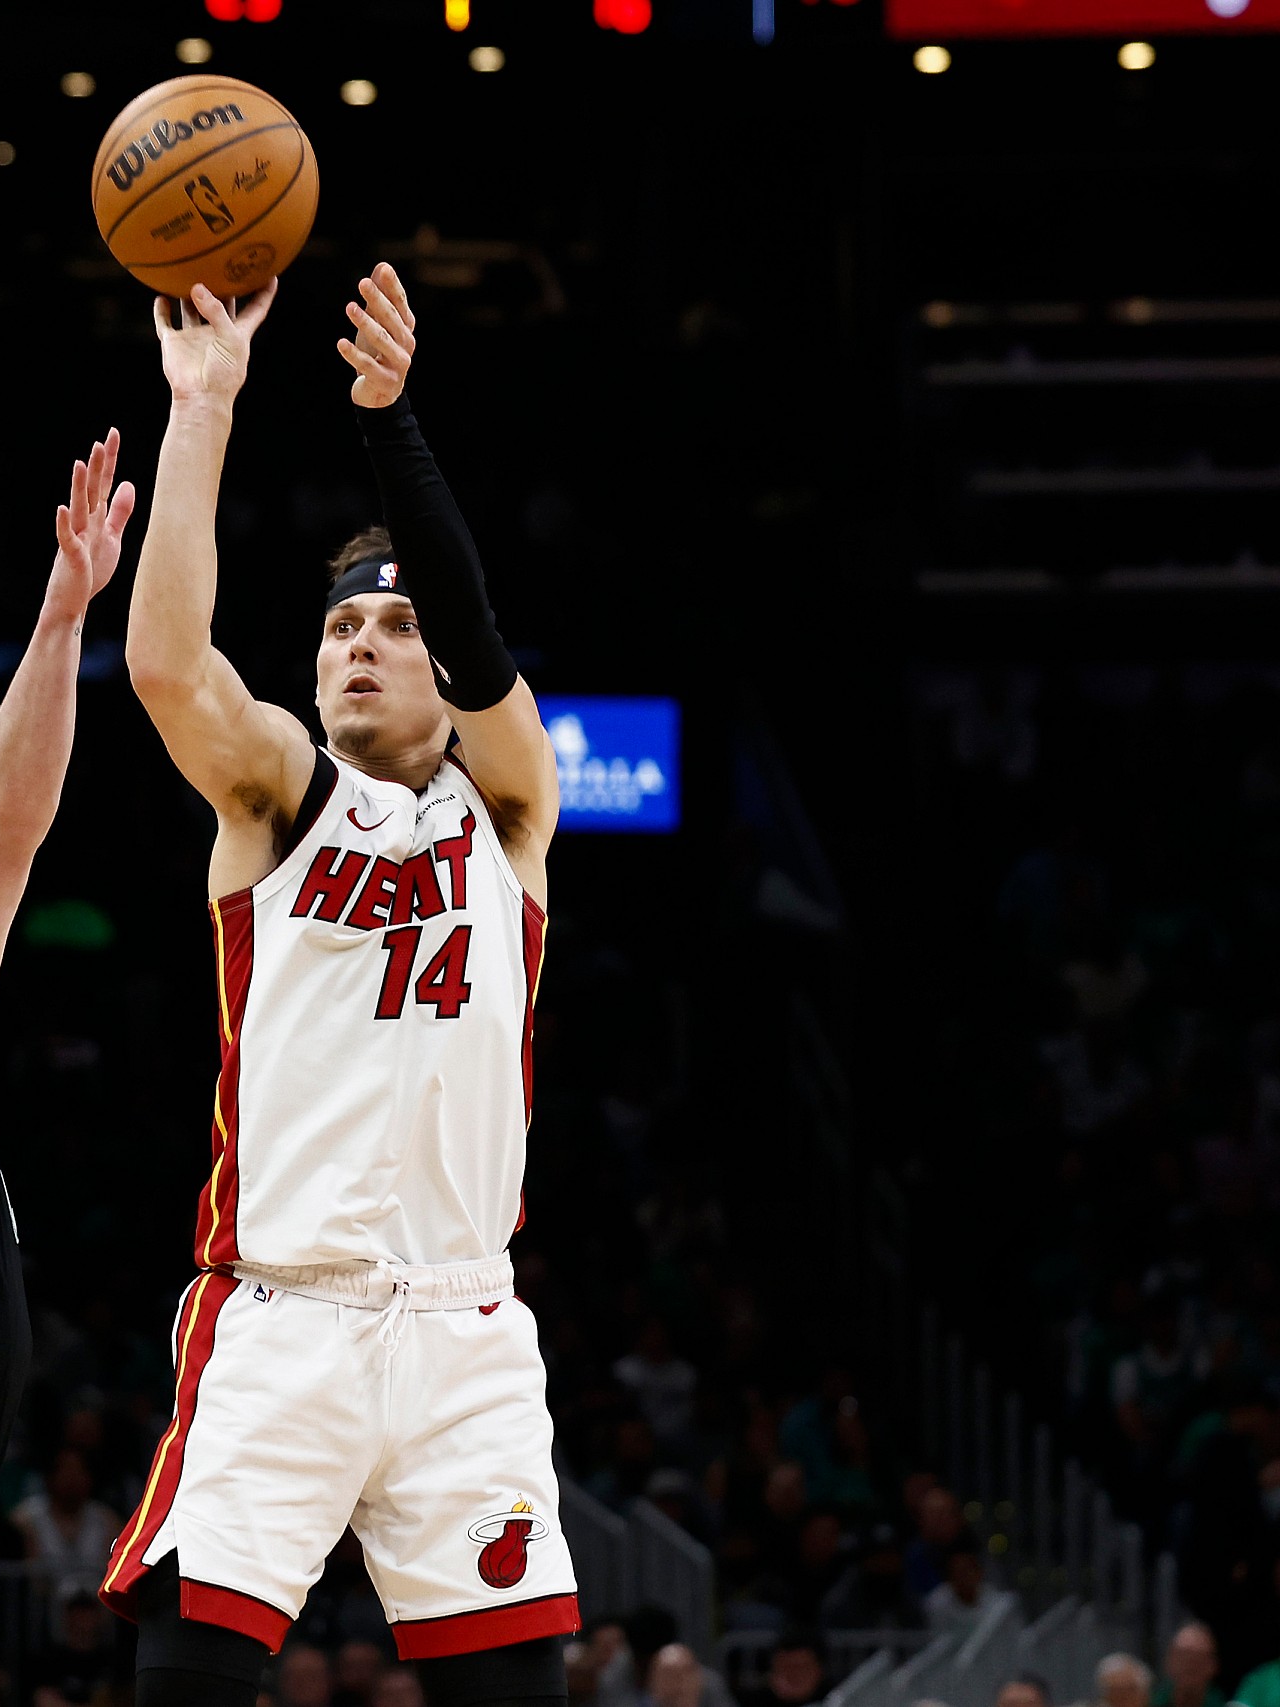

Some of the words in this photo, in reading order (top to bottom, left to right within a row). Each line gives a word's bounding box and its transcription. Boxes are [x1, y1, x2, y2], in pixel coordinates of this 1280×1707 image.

[107, 103, 245, 192] Wilson
[289, 805, 477, 931] HEAT
[374, 924, 473, 1020] 14
